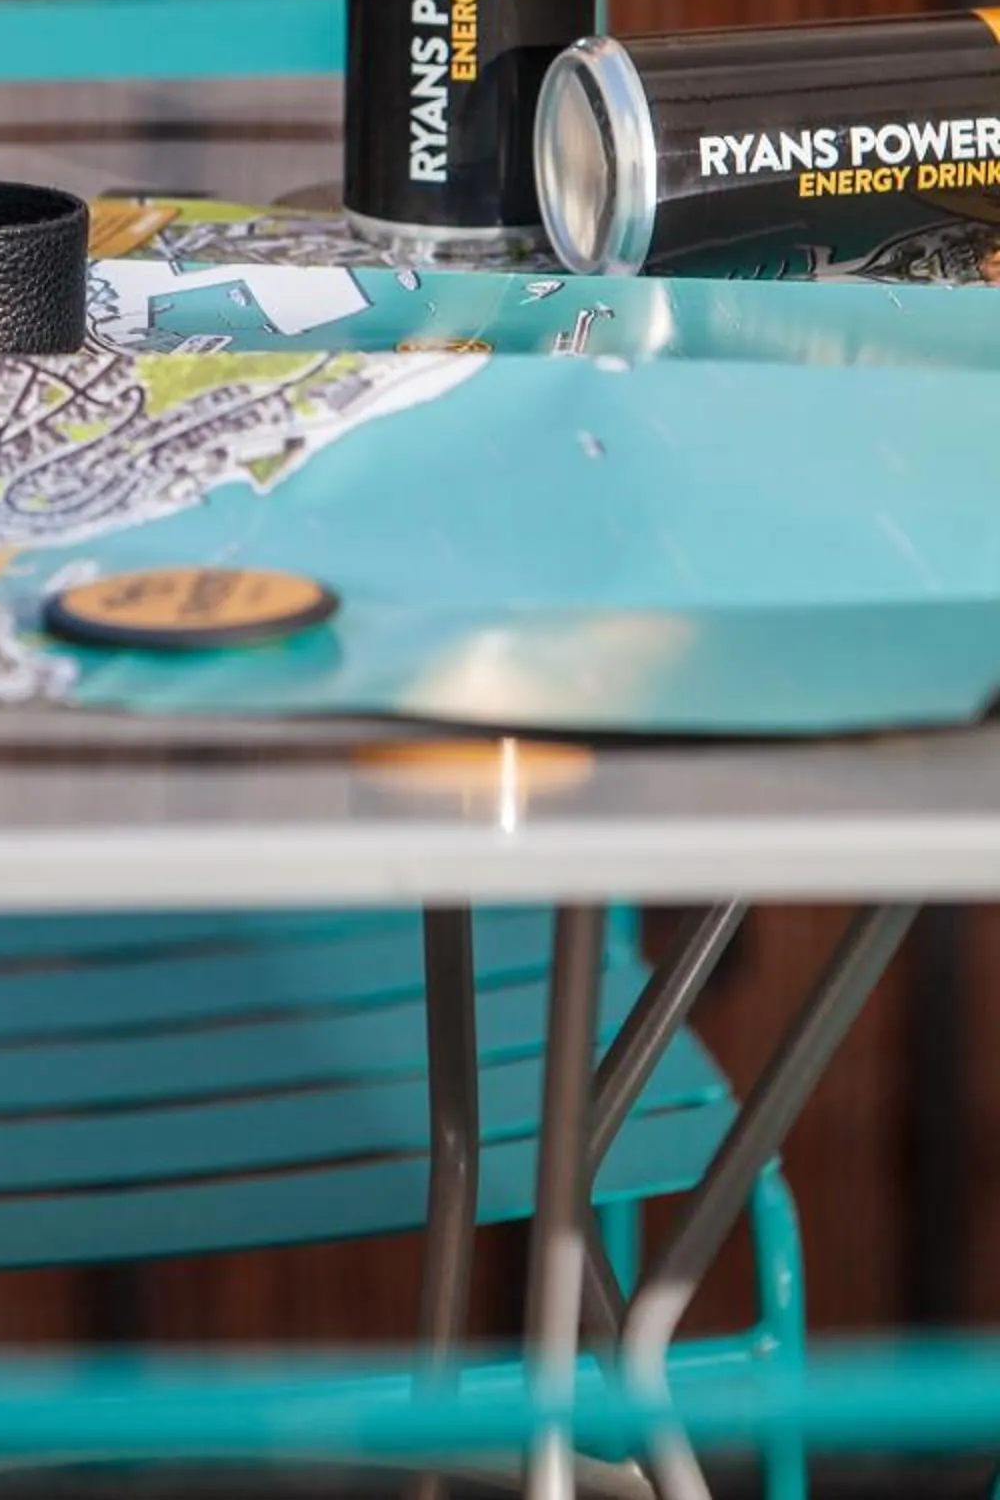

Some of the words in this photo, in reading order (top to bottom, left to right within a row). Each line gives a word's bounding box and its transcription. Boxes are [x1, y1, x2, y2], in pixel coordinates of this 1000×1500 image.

[410, 36, 449, 183] RYANS
[699, 129, 839, 177] RYANS
[850, 117, 1000, 167] POWER
[800, 165, 911, 197] ENERGY
